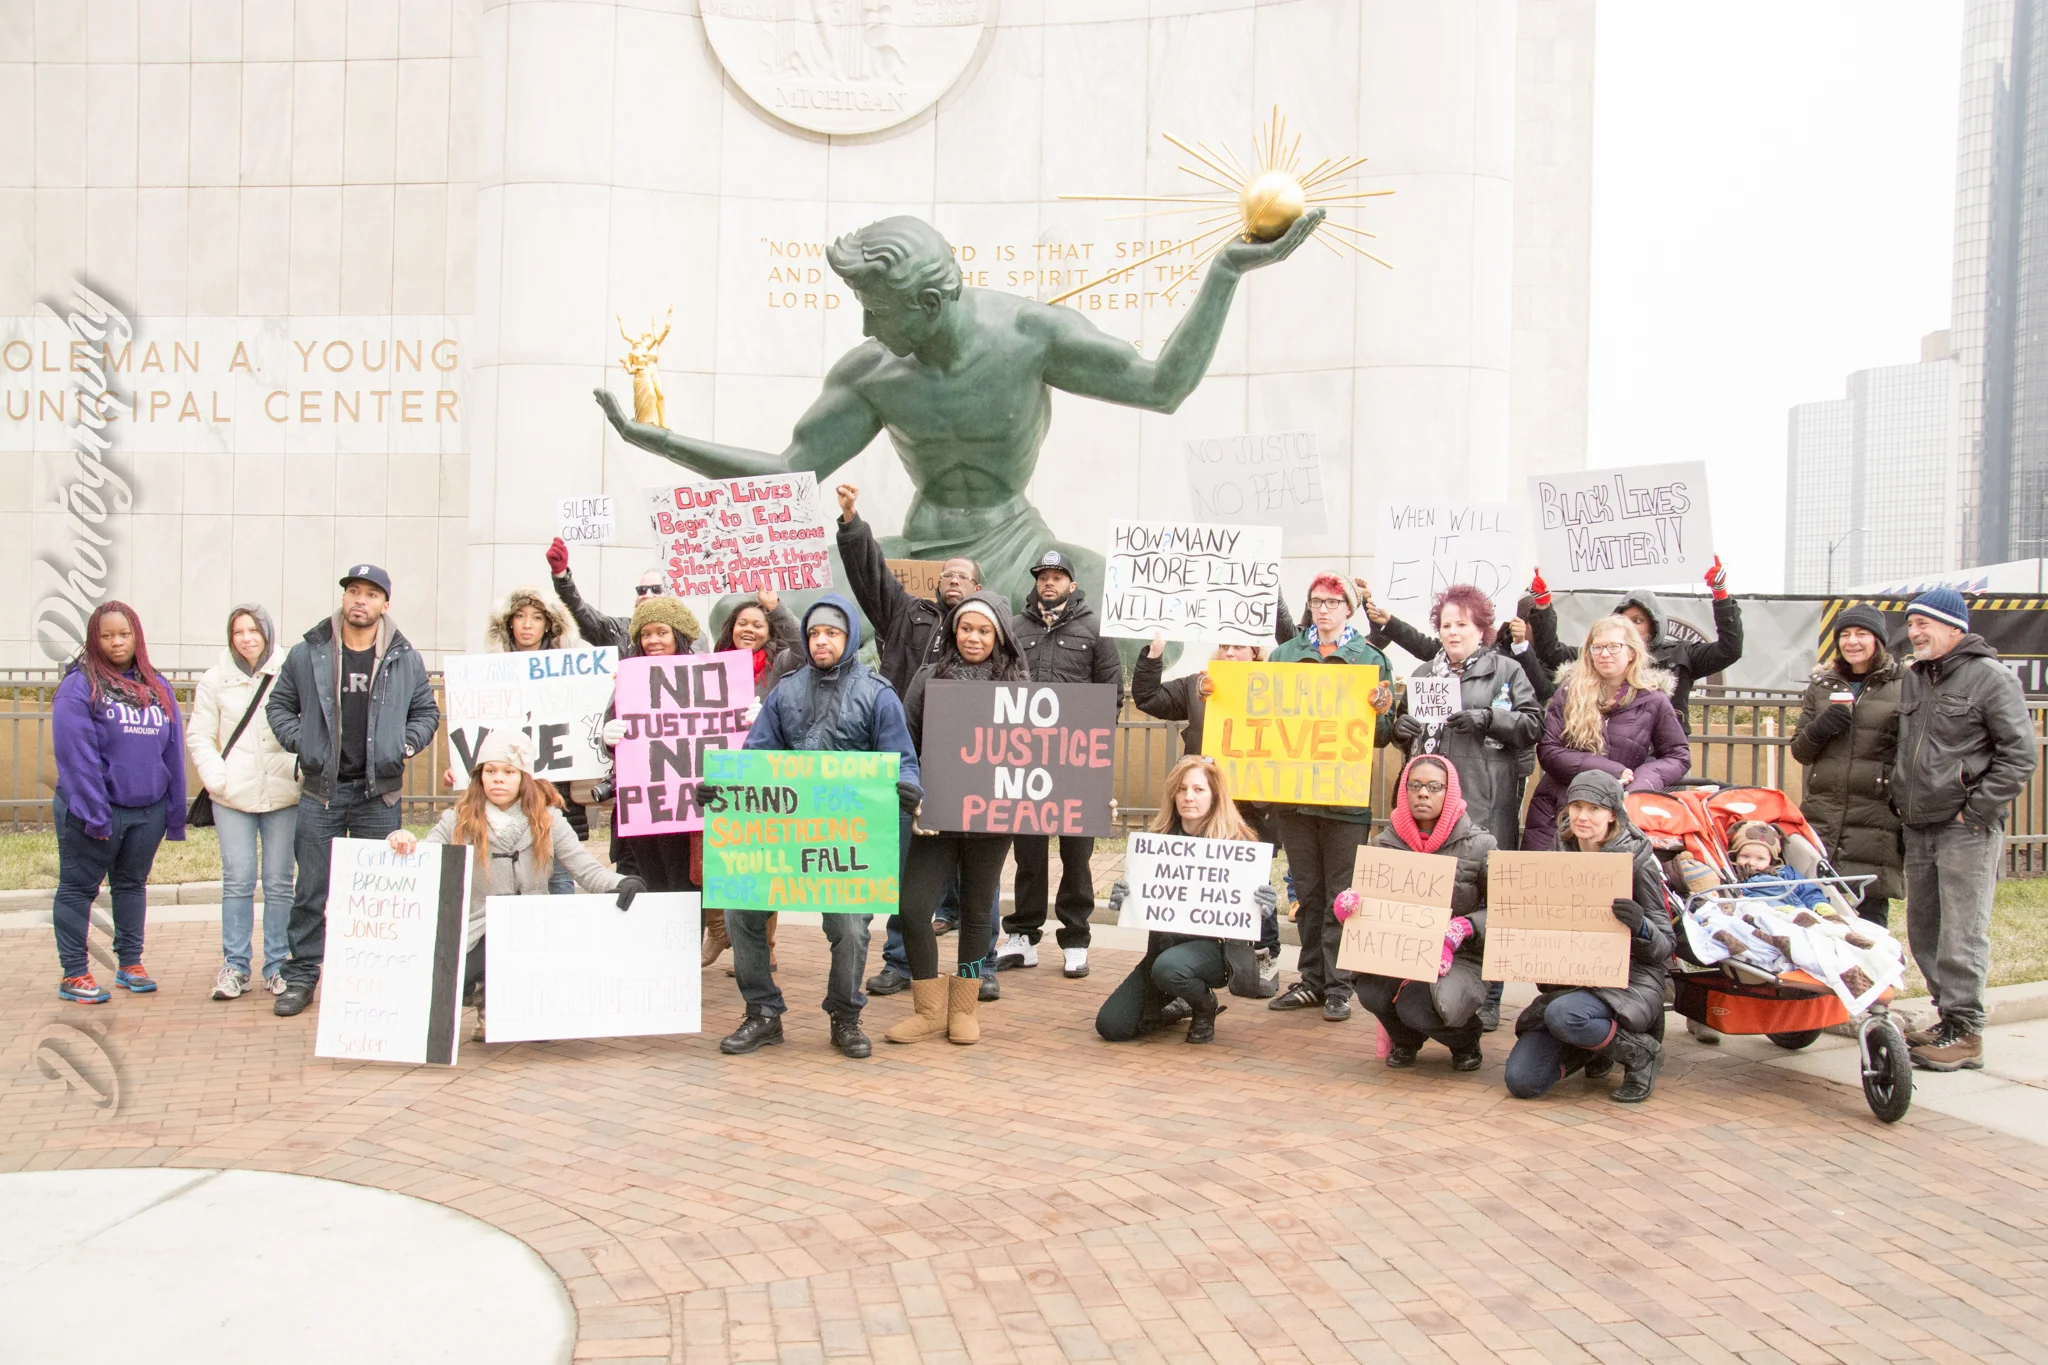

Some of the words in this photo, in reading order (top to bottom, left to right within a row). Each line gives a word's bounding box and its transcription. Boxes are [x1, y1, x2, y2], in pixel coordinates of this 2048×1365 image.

[776, 87, 908, 111] MICHIGAN
[996, 244, 1016, 262] IS
[1032, 243, 1095, 261] THAT
[1115, 238, 1201, 259] SPIRIT
[767, 266, 822, 284] AND
[1007, 269, 1089, 286] SPIRIT
[1106, 267, 1137, 284] OF
[1154, 264, 1200, 281] THE
[768, 291, 841, 310] LORD
[228, 340, 262, 373] A.
[293, 338, 459, 373] YOUNG
[264, 390, 459, 422] CENTER
[1183, 438, 1223, 465] NO
[1232, 432, 1319, 465] JUSTICE
[674, 487, 725, 510] Our
[1191, 481, 1244, 518] NO
[1248, 464, 1324, 512] PEACE
[563, 497, 610, 519] SILENCE
[657, 512, 708, 539] Begin
[718, 509, 742, 527] to
[752, 505, 791, 526] End
[1390, 504, 1435, 531] WHEN
[1449, 506, 1512, 533] WILL
[562, 523, 611, 542] CONSENT
[671, 539, 703, 556] the
[711, 535, 739, 554] day
[742, 533, 764, 545] we
[768, 525, 825, 542] become
[1115, 525, 1165, 551] HOW
[1169, 526, 1241, 554] MANY
[1432, 534, 1460, 557] IT
[667, 557, 725, 578] Silent
[728, 550, 779, 572] about
[782, 547, 829, 569] things
[1131, 556, 1200, 587] MORE
[1206, 559, 1279, 588] LIVES
[671, 574, 723, 597] that
[1105, 592, 1176, 622] WILL
[1185, 598, 1209, 619] WE
[1218, 599, 1277, 628] LOSE
[1668, 621, 1707, 644] WAYN
[528, 648, 612, 681] BLACK
[649, 661, 729, 709] NO
[1246, 671, 1357, 719] BLACK
[1415, 681, 1450, 695] BLACK
[992, 686, 1060, 728] NO
[1414, 705, 1454, 718] MATTER
[1420, 694, 1447, 706] LIVES
[123, 725, 160, 736] SANDUSKY
[623, 707, 753, 740] JUSTICE
[959, 726, 1112, 769] JUSTICE
[1221, 718, 1369, 762] LIVES
[708, 753, 754, 780] IF
[766, 753, 815, 780] YOU
[993, 765, 1054, 801] NO
[619, 782, 704, 826] PEA
[708, 784, 800, 815] STAND
[811, 784, 865, 812] FOR
[961, 794, 1084, 834] PEACE
[708, 816, 869, 849] SOMETHING
[800, 844, 870, 874] FALL
[1134, 838, 1197, 858] BLACK
[1205, 843, 1257, 863] LIVES
[352, 871, 417, 893] BROWN
[1154, 862, 1231, 884] MATTER
[1356, 862, 1445, 898] #BLACK
[707, 874, 760, 903] FOR
[767, 876, 900, 906] ANYTHING
[1141, 882, 1189, 902] LOVE
[1200, 887, 1242, 905] HAS
[347, 894, 423, 921] Martin
[1145, 904, 1176, 923] NO
[1189, 908, 1252, 929] COLOR
[1359, 899, 1436, 929] LIVES
[343, 918, 399, 941] JONES
[345, 946, 418, 970] Brother
[1345, 928, 1435, 969] MATTER
[343, 999, 401, 1028] Friend
[336, 1032, 388, 1055] Sister
